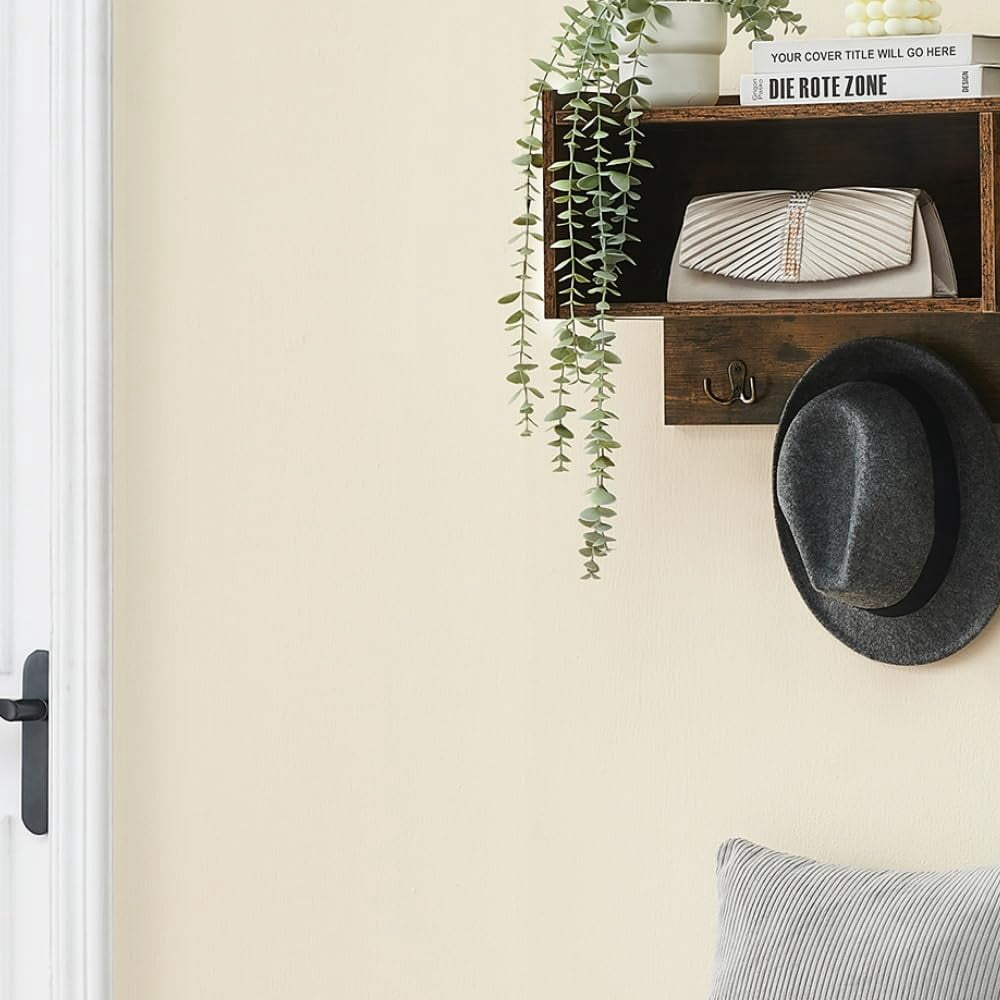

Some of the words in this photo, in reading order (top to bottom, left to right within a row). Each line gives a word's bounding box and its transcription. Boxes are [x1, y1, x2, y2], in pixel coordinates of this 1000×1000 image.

[771, 52, 802, 63] YOUR
[804, 51, 842, 62] COVER
[845, 49, 875, 60] TITLE
[877, 48, 904, 58] WILL
[907, 47, 924, 57] GO
[926, 46, 956, 56] HERE
[769, 77, 795, 99] DIE
[799, 76, 840, 98] ROTE
[844, 74, 888, 96] ZONE
[961, 71, 969, 93] DESIGN
